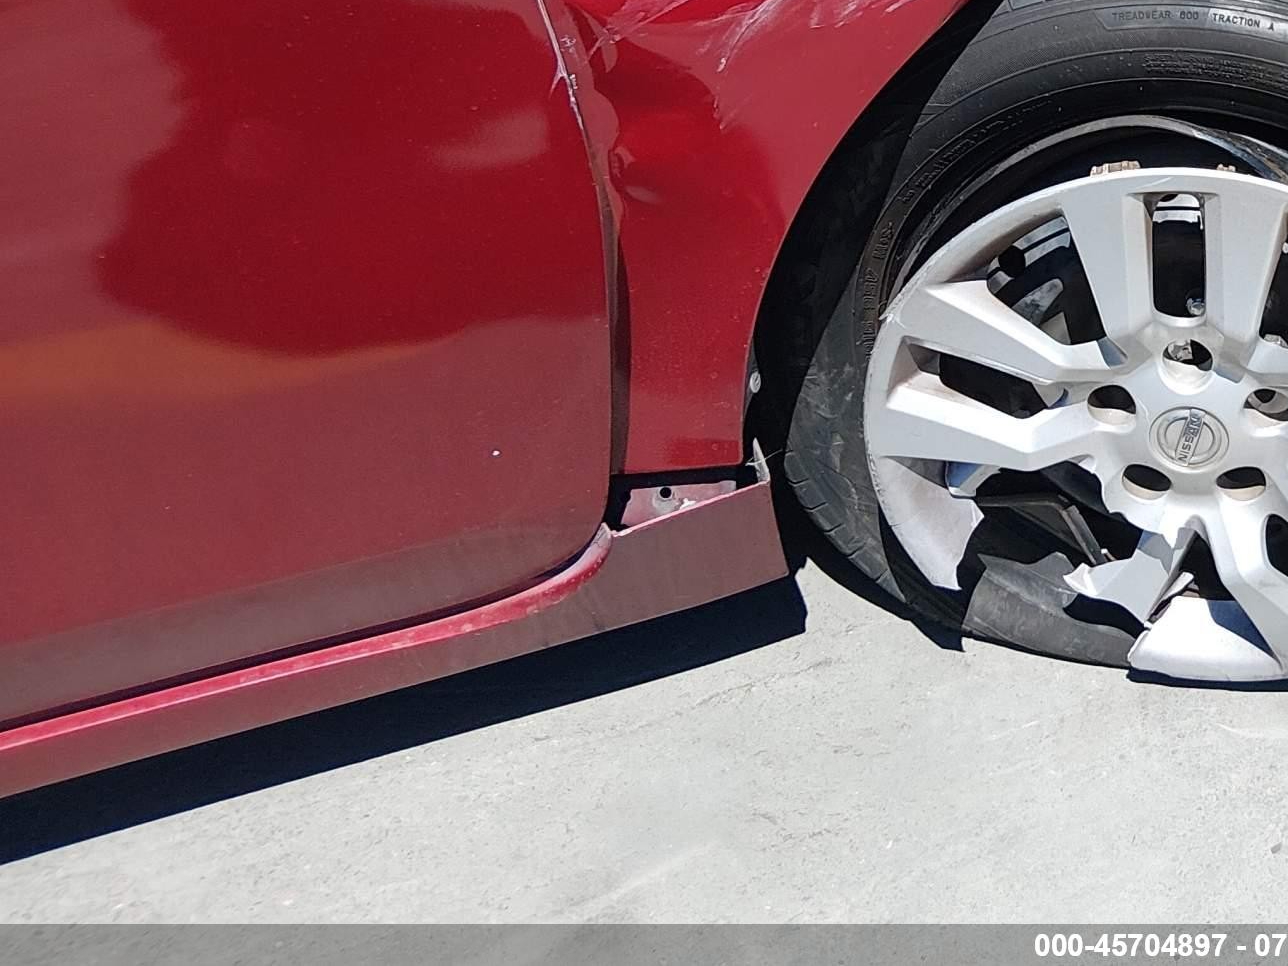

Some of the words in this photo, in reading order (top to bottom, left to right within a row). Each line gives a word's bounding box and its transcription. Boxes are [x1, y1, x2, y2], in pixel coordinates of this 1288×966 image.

[1111, 10, 1172, 21] TREADWEAR
[1213, 12, 1261, 29] TRACTION
[1268, 22, 1275, 32] A
[1177, 415, 1203, 463] NISSAN
